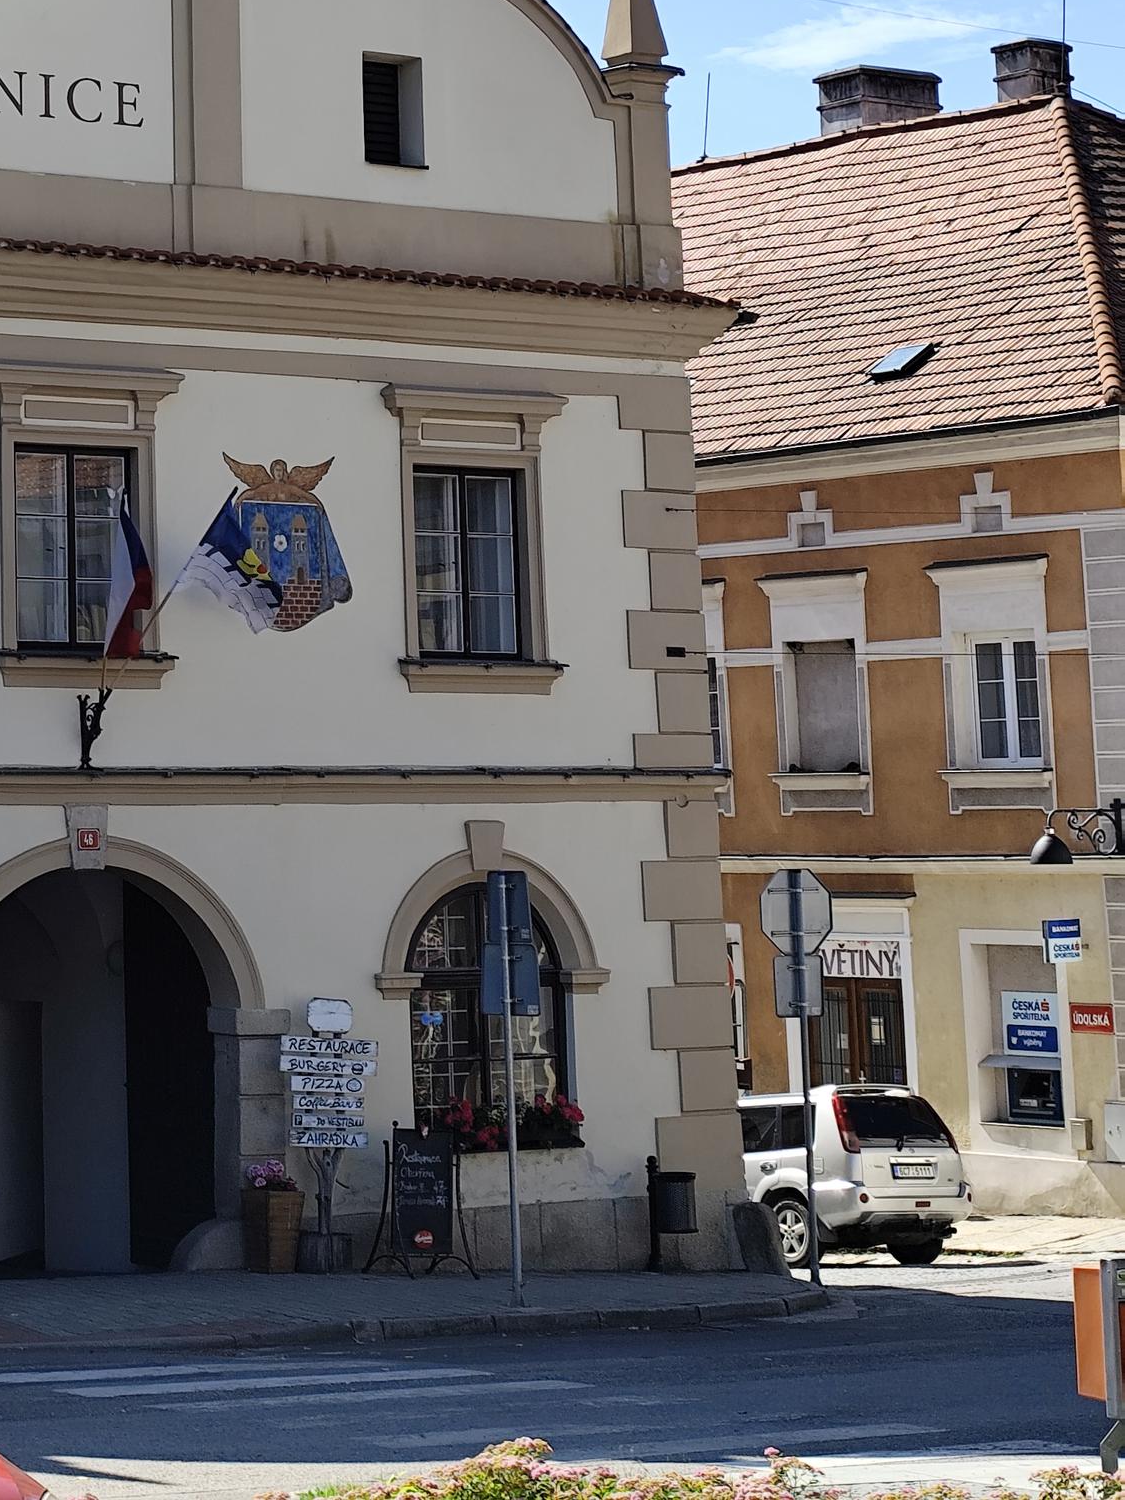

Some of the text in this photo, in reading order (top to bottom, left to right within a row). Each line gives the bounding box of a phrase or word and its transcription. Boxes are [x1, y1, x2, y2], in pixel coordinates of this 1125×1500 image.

[83, 833, 94, 846] 46
[819, 943, 898, 976] VĚTINY
[1012, 998, 1040, 1012] ČESKÁ
[1012, 1012, 1050, 1021] SPOŘITELNA
[1072, 1010, 1110, 1026] ÚDOLSKÁ
[288, 1037, 371, 1055] RESTAURACE
[287, 1058, 346, 1073] BURGERY
[301, 1077, 343, 1091] PIZZA
